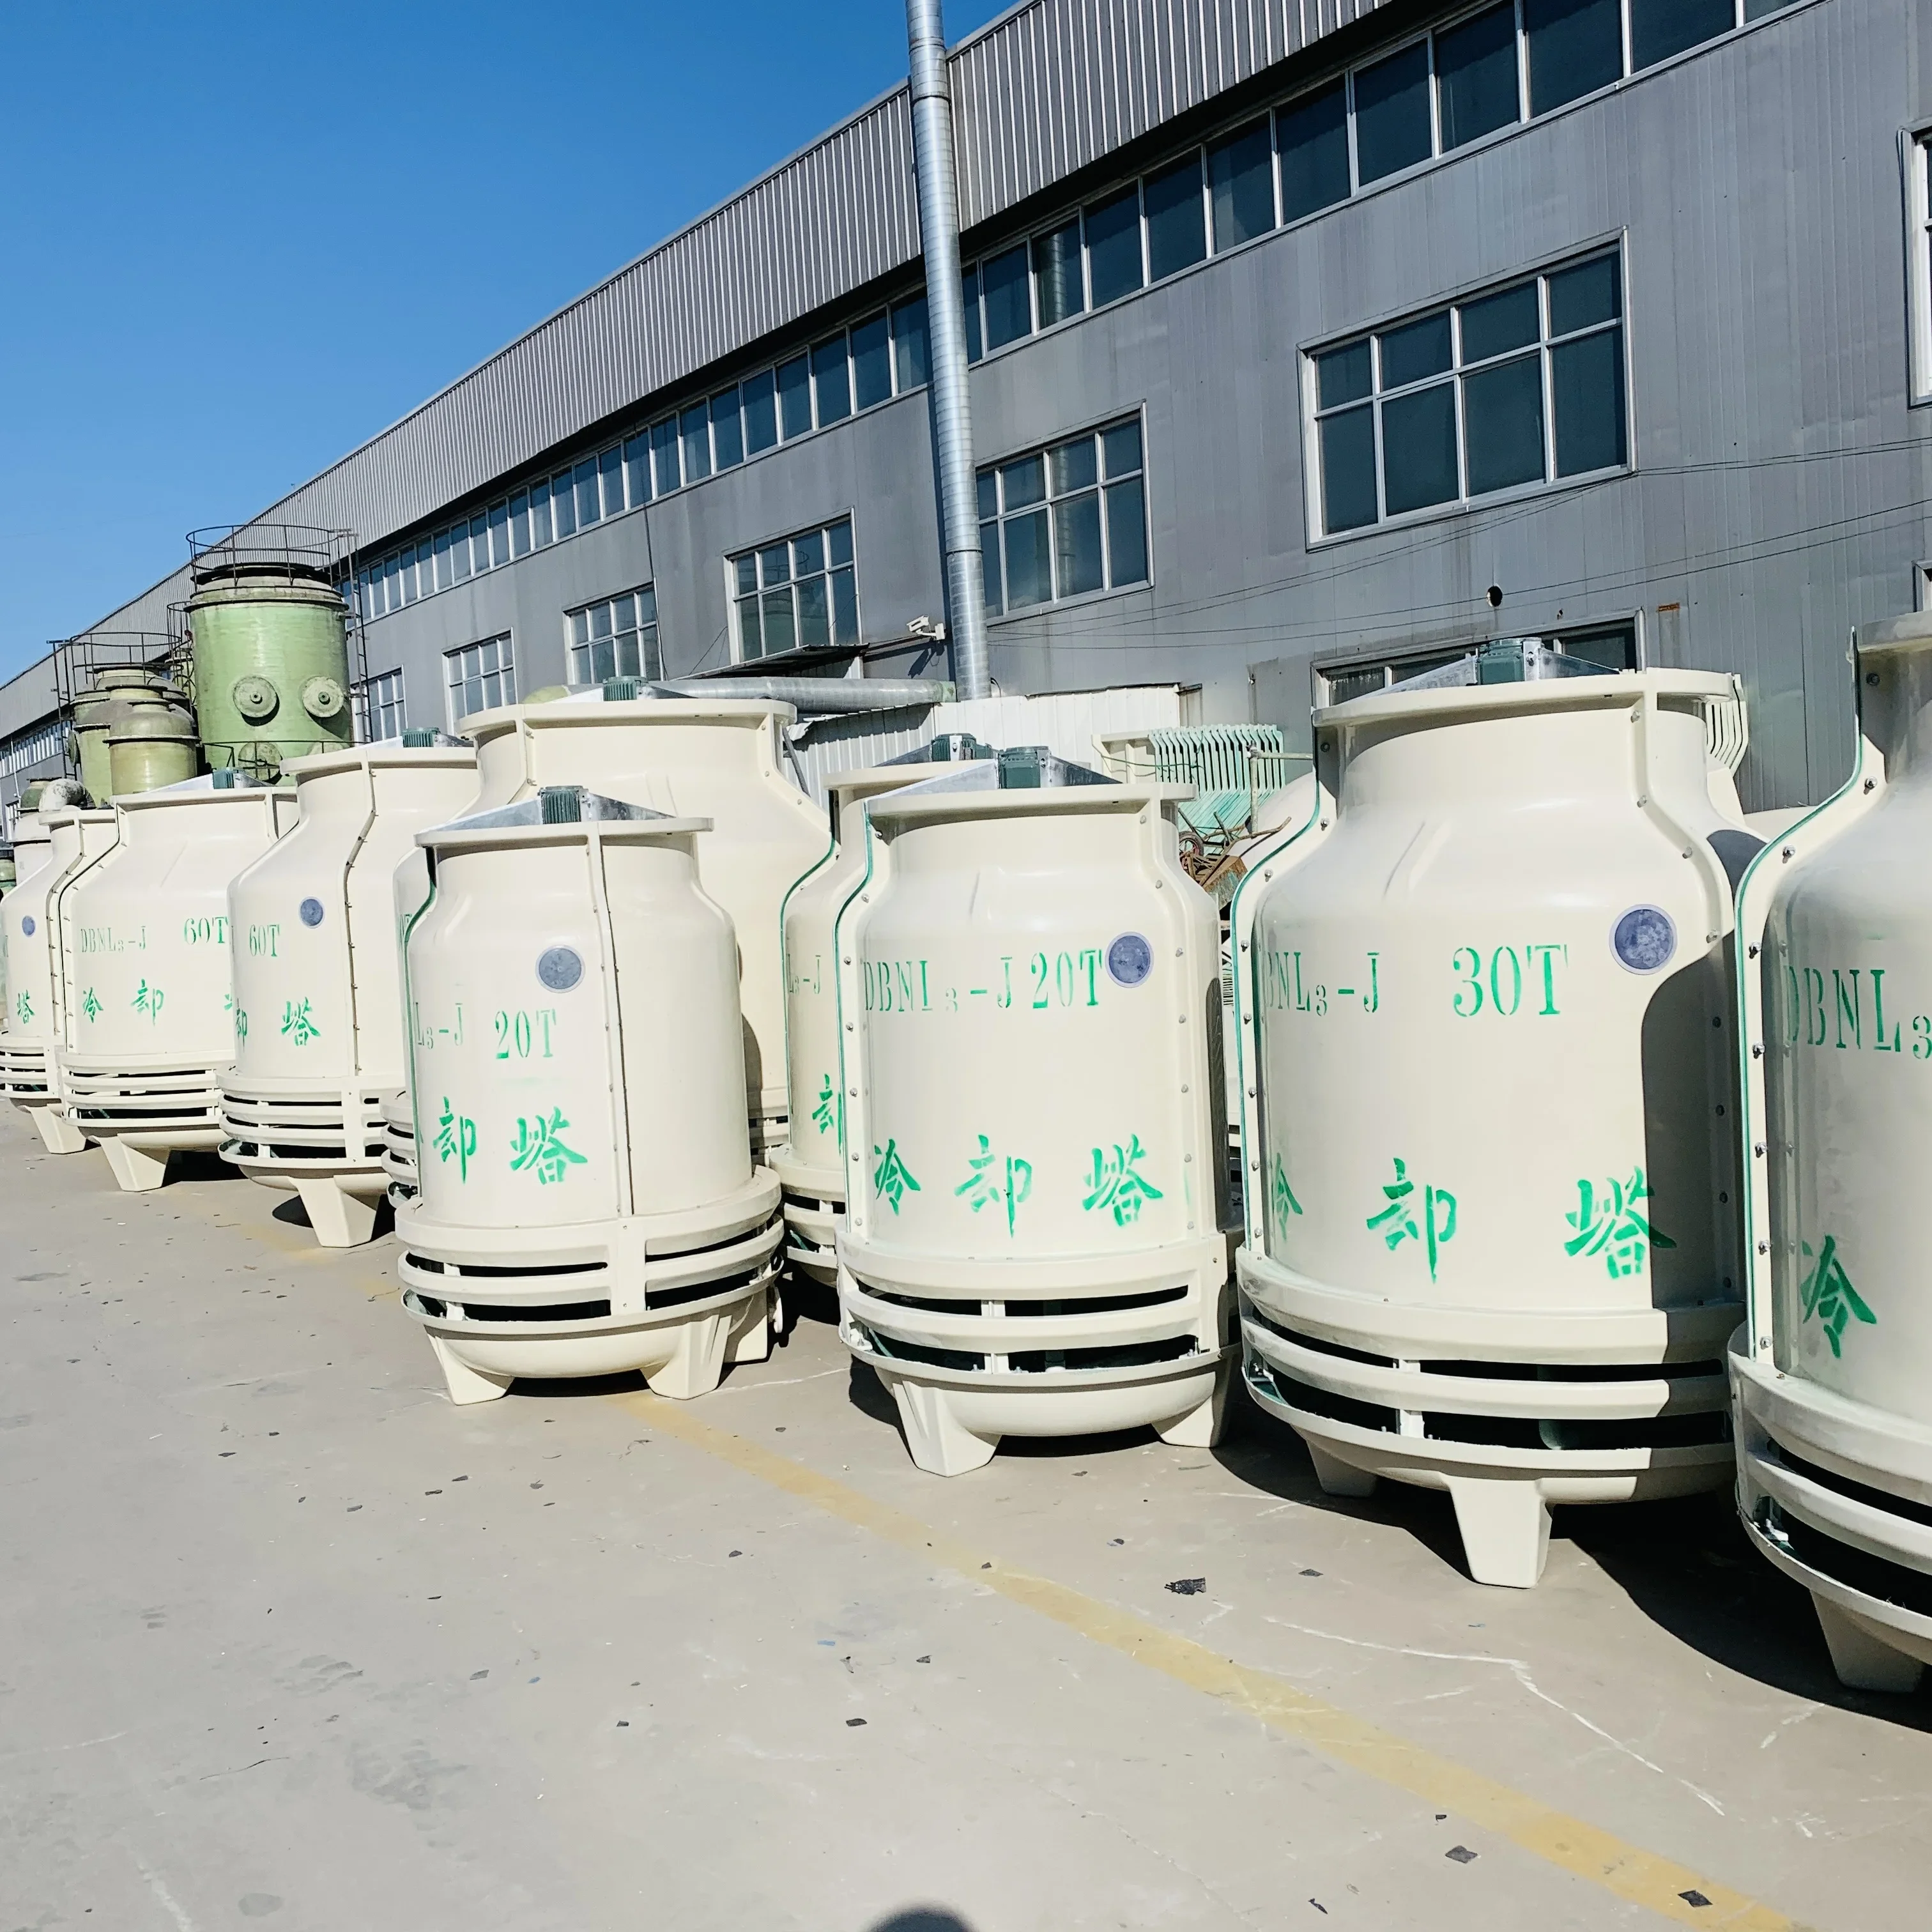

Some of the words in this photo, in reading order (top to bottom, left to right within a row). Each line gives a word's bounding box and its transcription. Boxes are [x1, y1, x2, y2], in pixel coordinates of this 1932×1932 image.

[184, 916, 228, 945] 60T
[249, 924, 280, 957] 60T
[1031, 949, 1103, 1009] 20T
[1453, 944, 1568, 1017] 30T
[495, 1008, 556, 1059] 20T
